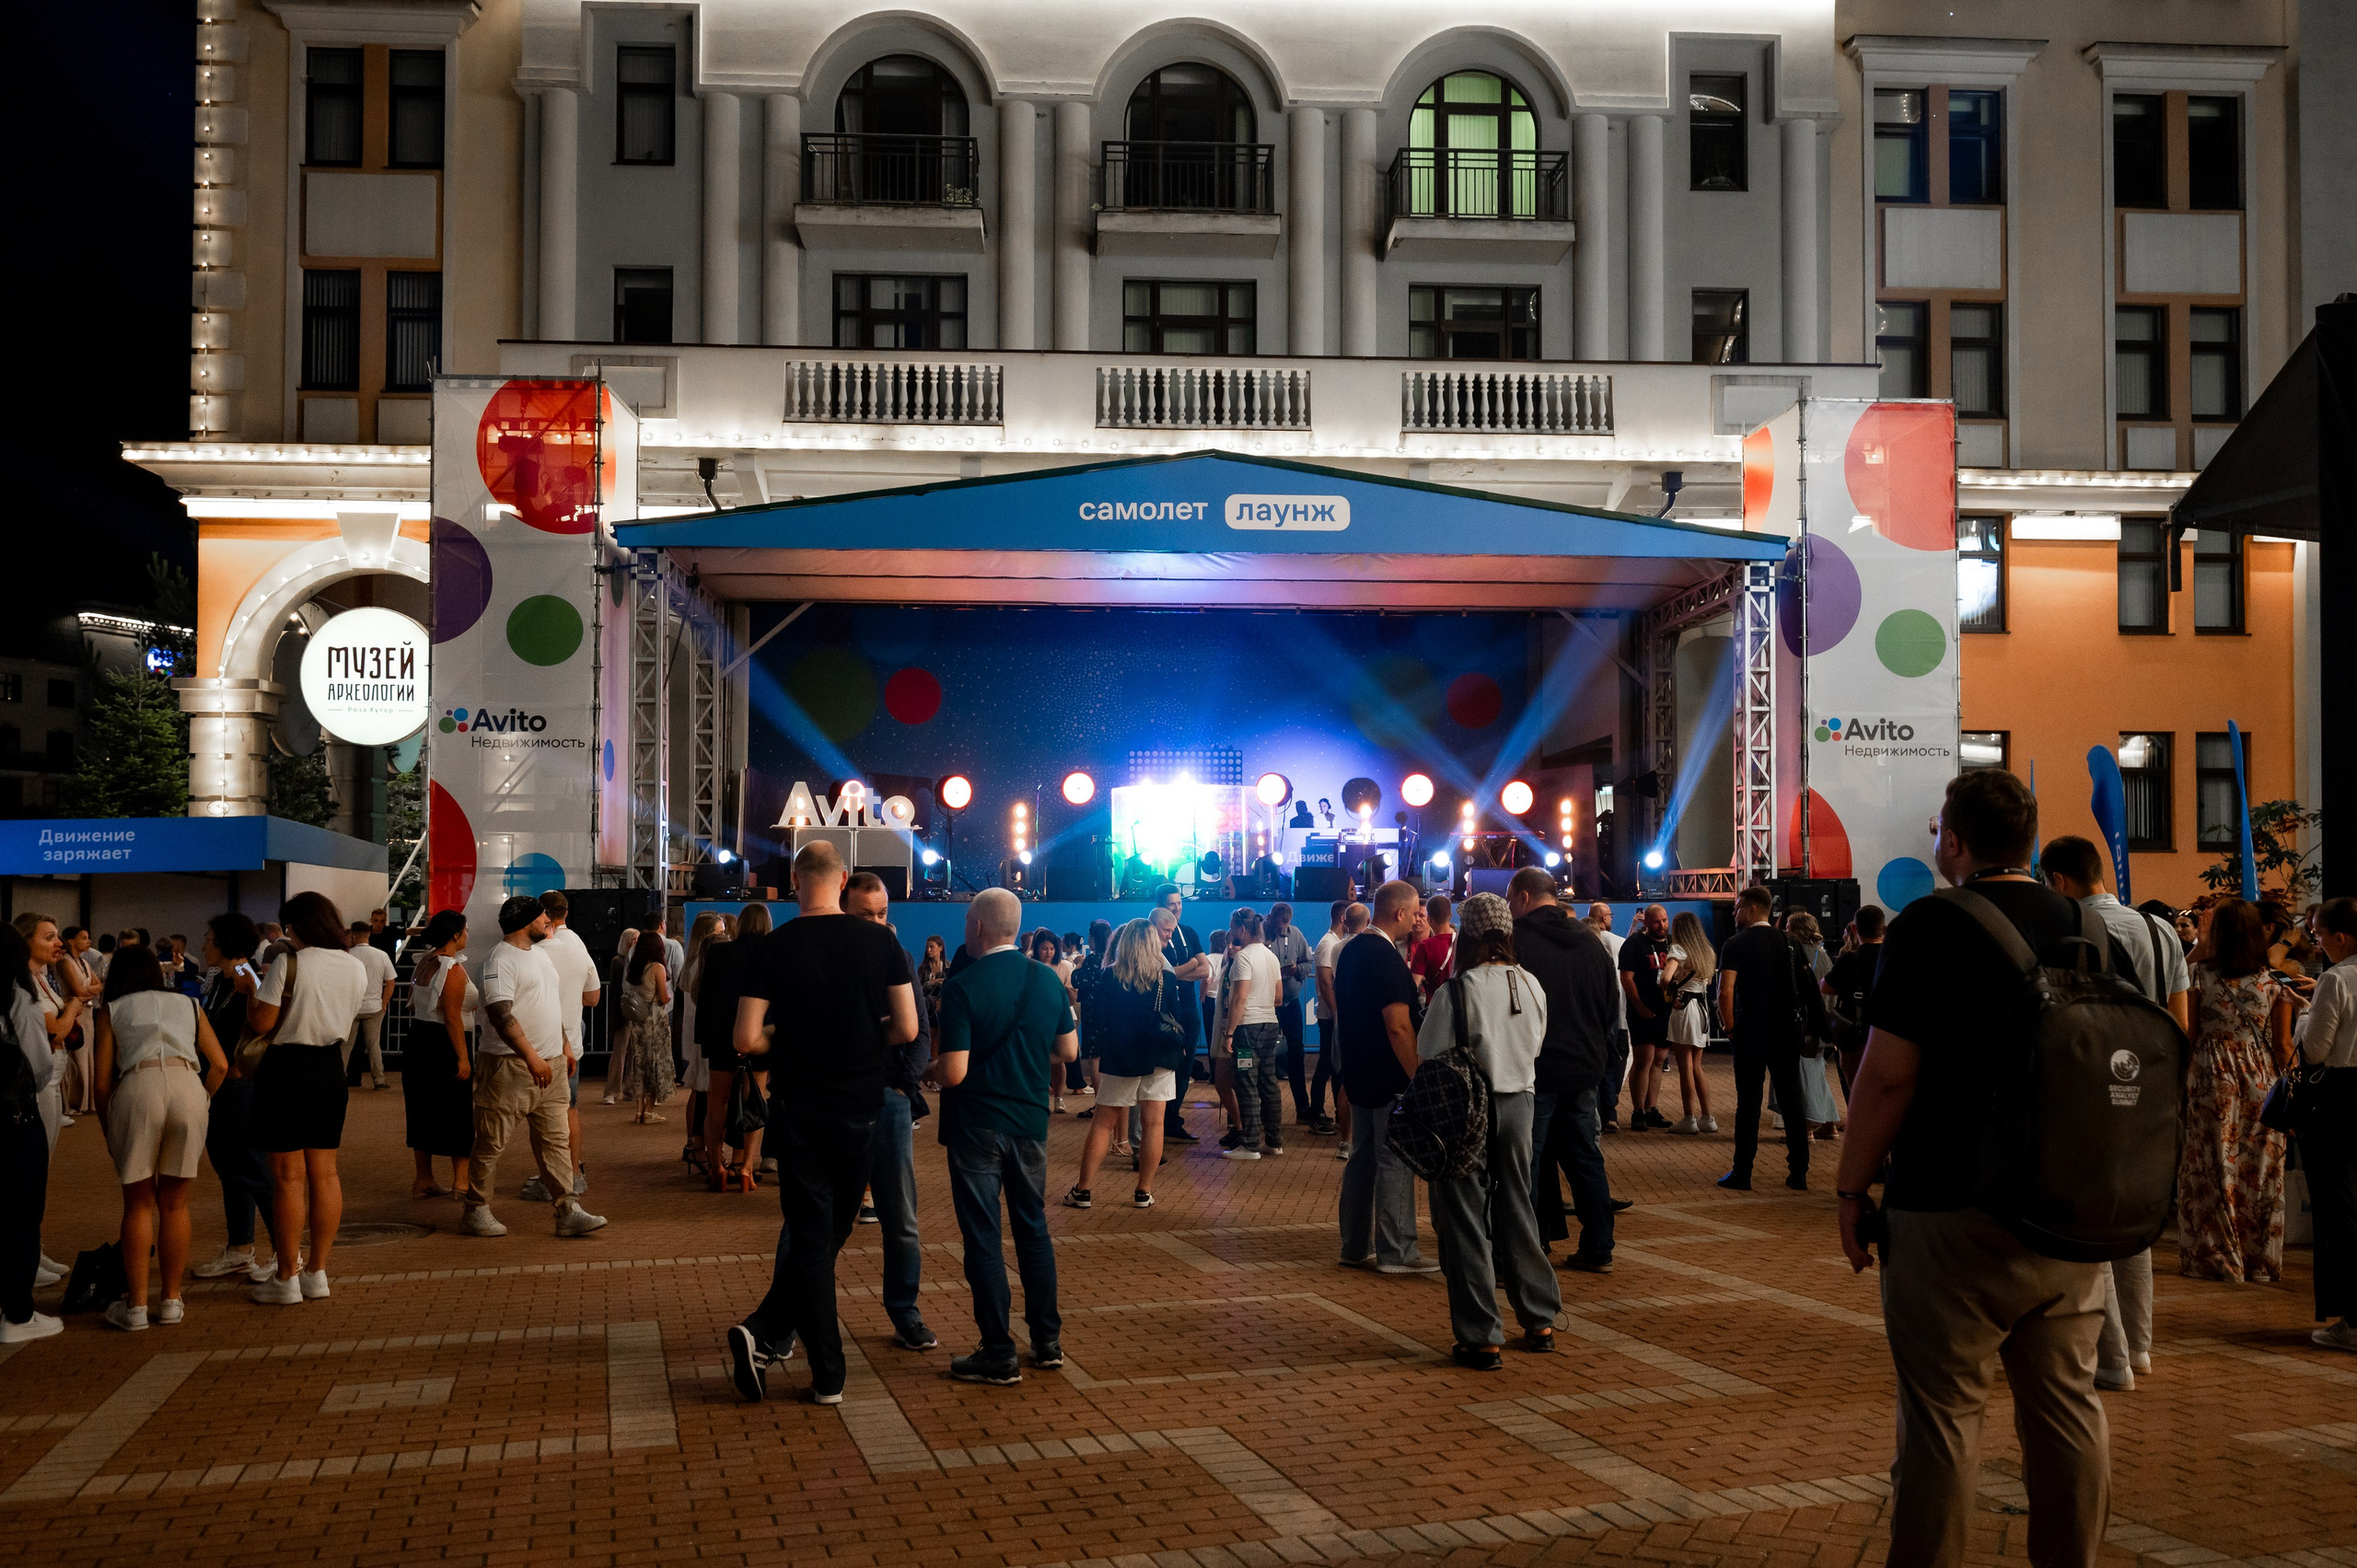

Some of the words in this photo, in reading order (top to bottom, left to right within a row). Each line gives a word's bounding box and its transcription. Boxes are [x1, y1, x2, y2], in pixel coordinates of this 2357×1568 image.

[1078, 501, 1209, 521] самолет
[1236, 502, 1337, 528] лаунж
[328, 641, 414, 679] МУЗЕЙ
[328, 683, 414, 702] АРХЕОЛОГИИ
[470, 708, 547, 733] Avito
[1844, 718, 1914, 741] Avito
[471, 736, 586, 749] Недвижимость
[1844, 745, 1950, 758] Недвижимость
[777, 782, 915, 828] Avito
[38, 829, 136, 846] Движение
[42, 849, 133, 865] заряжает
[1286, 851, 1335, 865] Движе
[2108, 1085, 2141, 1093] SECURITY
[2109, 1091, 2140, 1100] ANALYST
